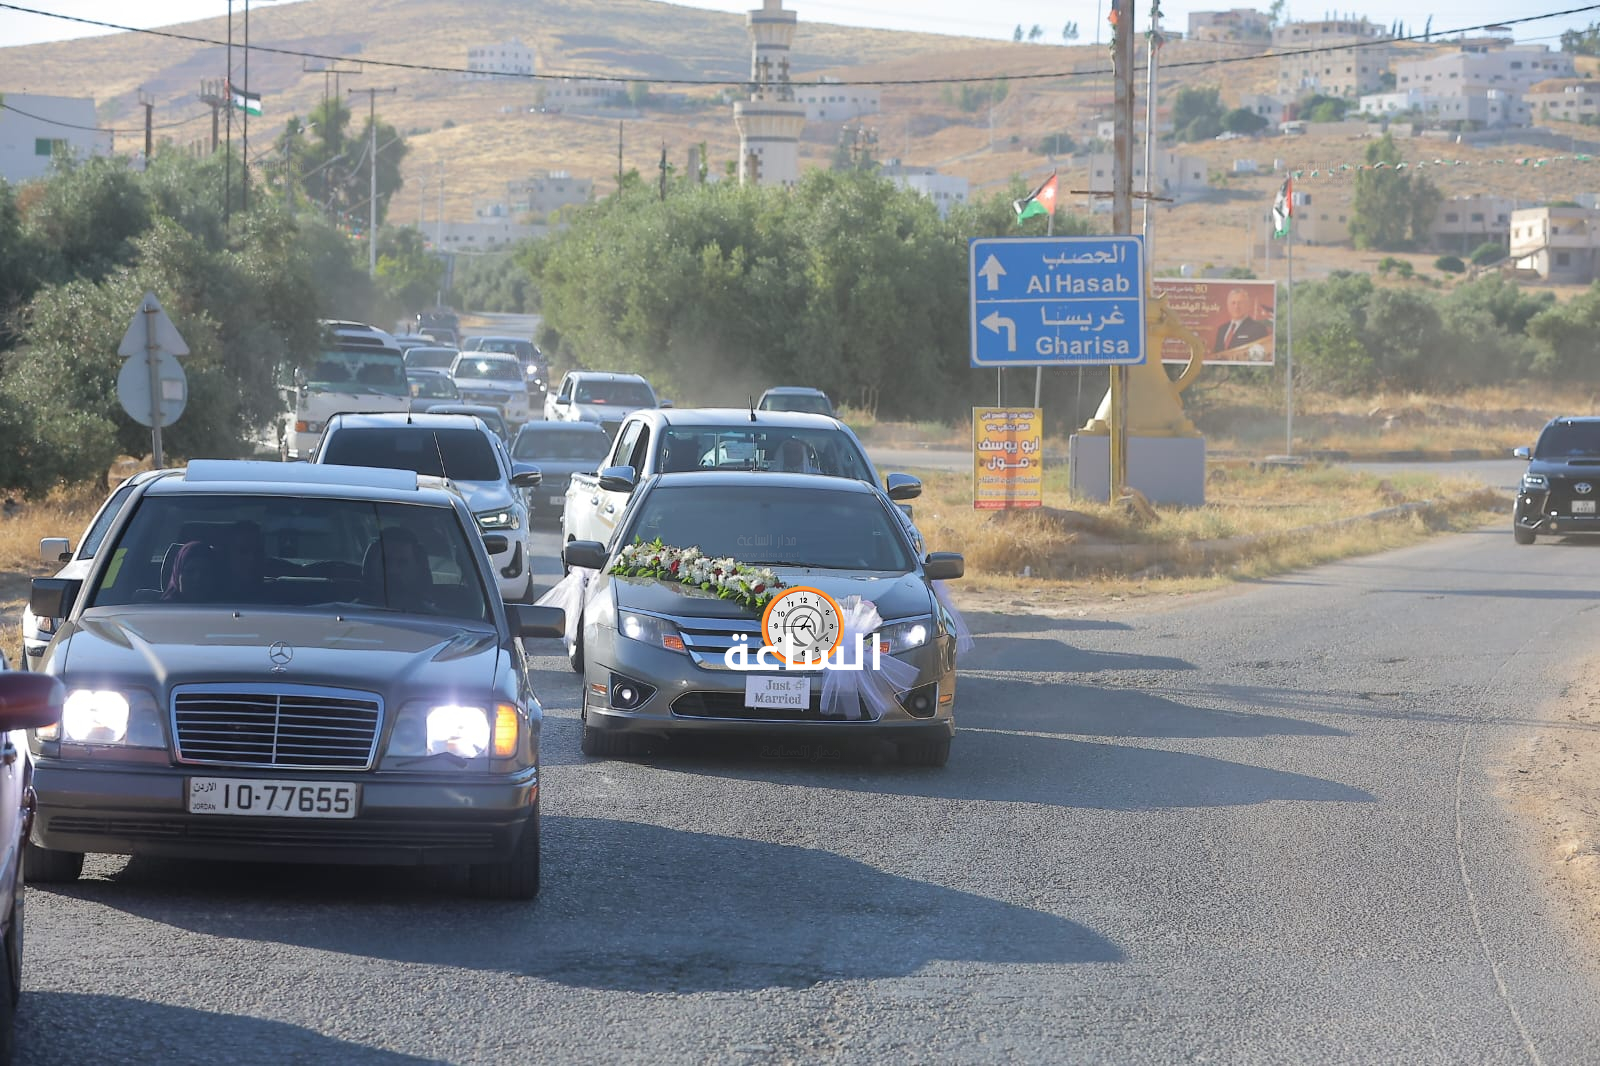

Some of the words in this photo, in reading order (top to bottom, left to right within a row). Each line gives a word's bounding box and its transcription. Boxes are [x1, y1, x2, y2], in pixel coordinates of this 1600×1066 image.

[1043, 243, 1126, 270] الحصب
[1026, 275, 1050, 294] Al
[1056, 273, 1130, 294] Hasab
[1041, 305, 1126, 331] غريسا
[1035, 336, 1130, 355] Gharisa
[978, 438, 1018, 454] يوسف
[766, 679, 791, 690] Just
[755, 692, 801, 704] Married
[192, 803, 216, 811] JORDAN
[223, 784, 350, 813] 10-77655
